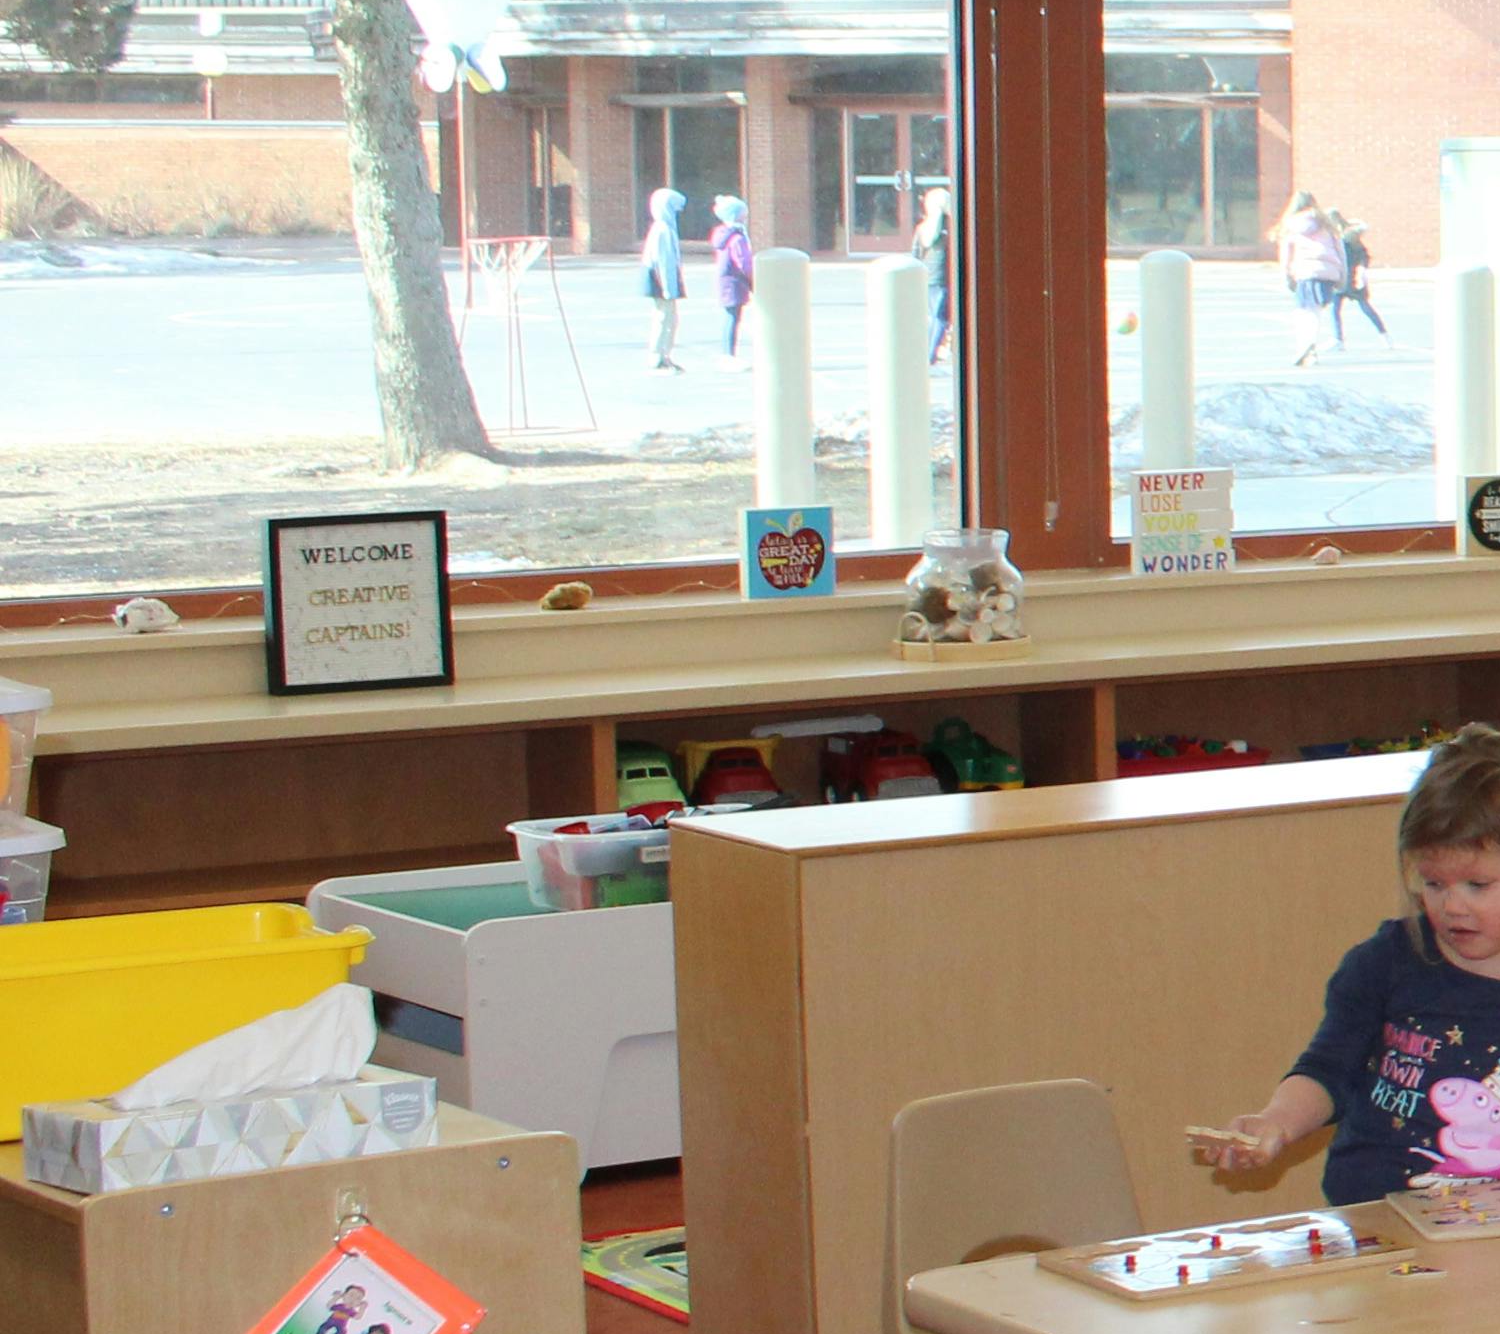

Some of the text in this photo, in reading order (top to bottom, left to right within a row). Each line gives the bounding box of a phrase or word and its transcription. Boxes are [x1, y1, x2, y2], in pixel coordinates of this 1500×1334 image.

[1139, 473, 1205, 492] NEVER
[1141, 493, 1183, 513] LOSE
[1143, 513, 1198, 532] YOUR
[301, 542, 414, 566] WELCOME
[760, 544, 810, 557] GREAT
[789, 554, 818, 566] DAY
[1142, 551, 1228, 573] WONDER
[308, 584, 411, 607] CREATIVE
[305, 623, 412, 645] CAPTAINS!
[1382, 1055, 1425, 1089] OWN
[1371, 1076, 1426, 1118] BEAT
